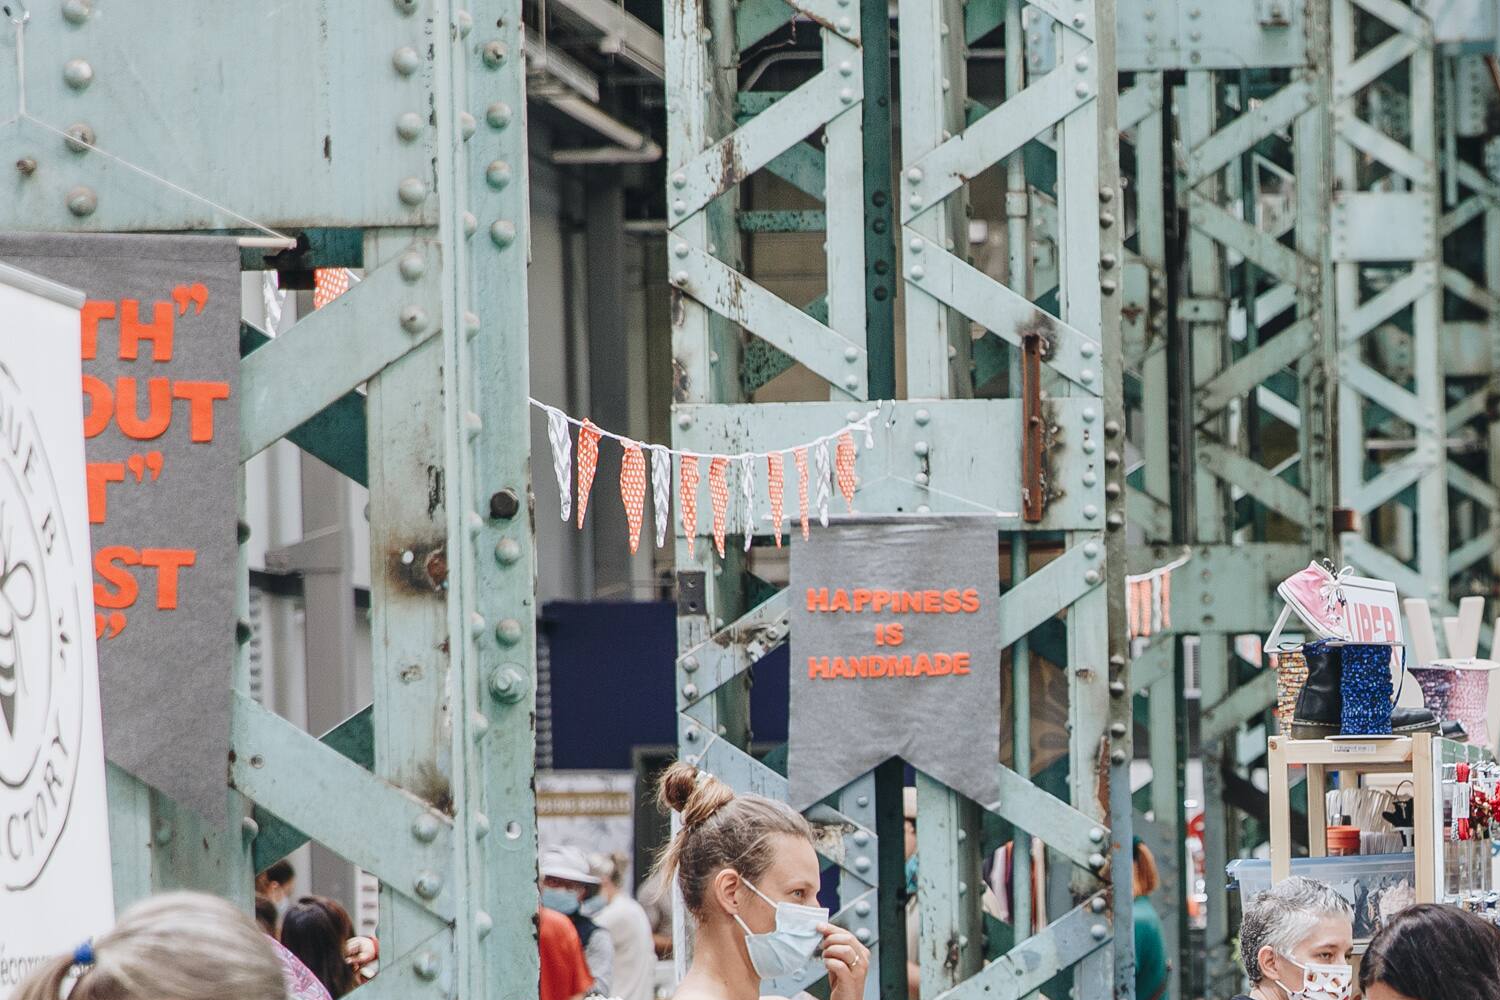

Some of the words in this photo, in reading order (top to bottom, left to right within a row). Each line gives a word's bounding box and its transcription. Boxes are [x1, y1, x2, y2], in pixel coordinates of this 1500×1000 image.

[82, 373, 230, 442] OUT
[94, 546, 197, 611] ST
[806, 588, 981, 613] HAPPINESS
[874, 623, 905, 646] IS
[807, 652, 972, 680] HANDMADE
[6, 706, 69, 861] CTORY
